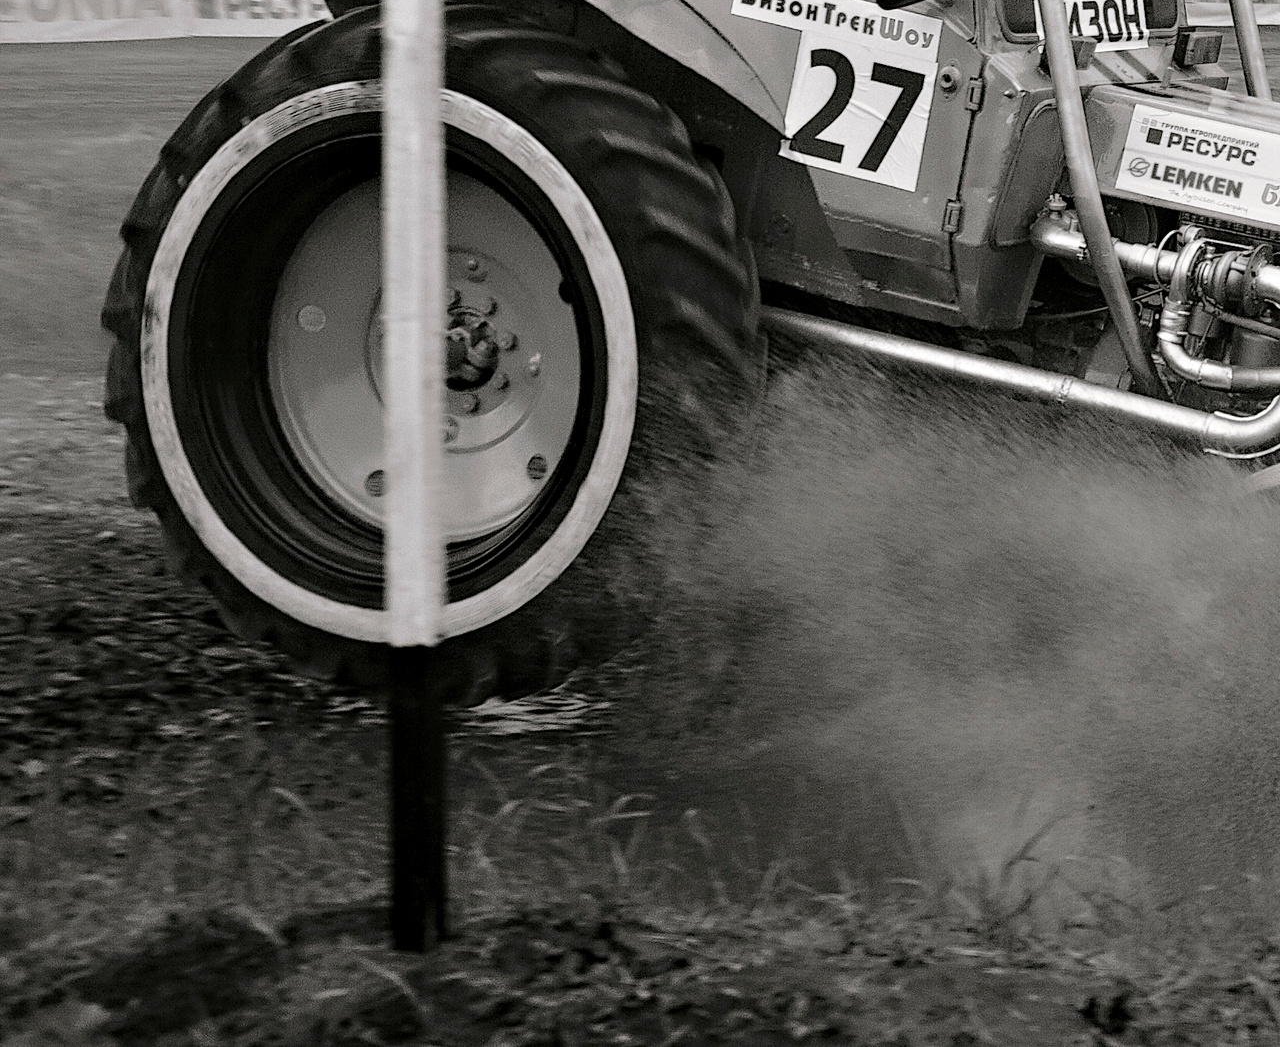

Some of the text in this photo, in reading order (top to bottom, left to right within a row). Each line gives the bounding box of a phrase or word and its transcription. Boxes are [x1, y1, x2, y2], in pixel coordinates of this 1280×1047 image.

[789, 49, 925, 172] 27
[1160, 122, 1260, 149] ГРУППА АГРОПРЕДПРИЯТИЙ
[1166, 132, 1257, 166] РЕСУРС
[1150, 163, 1243, 199] LEMKEN
